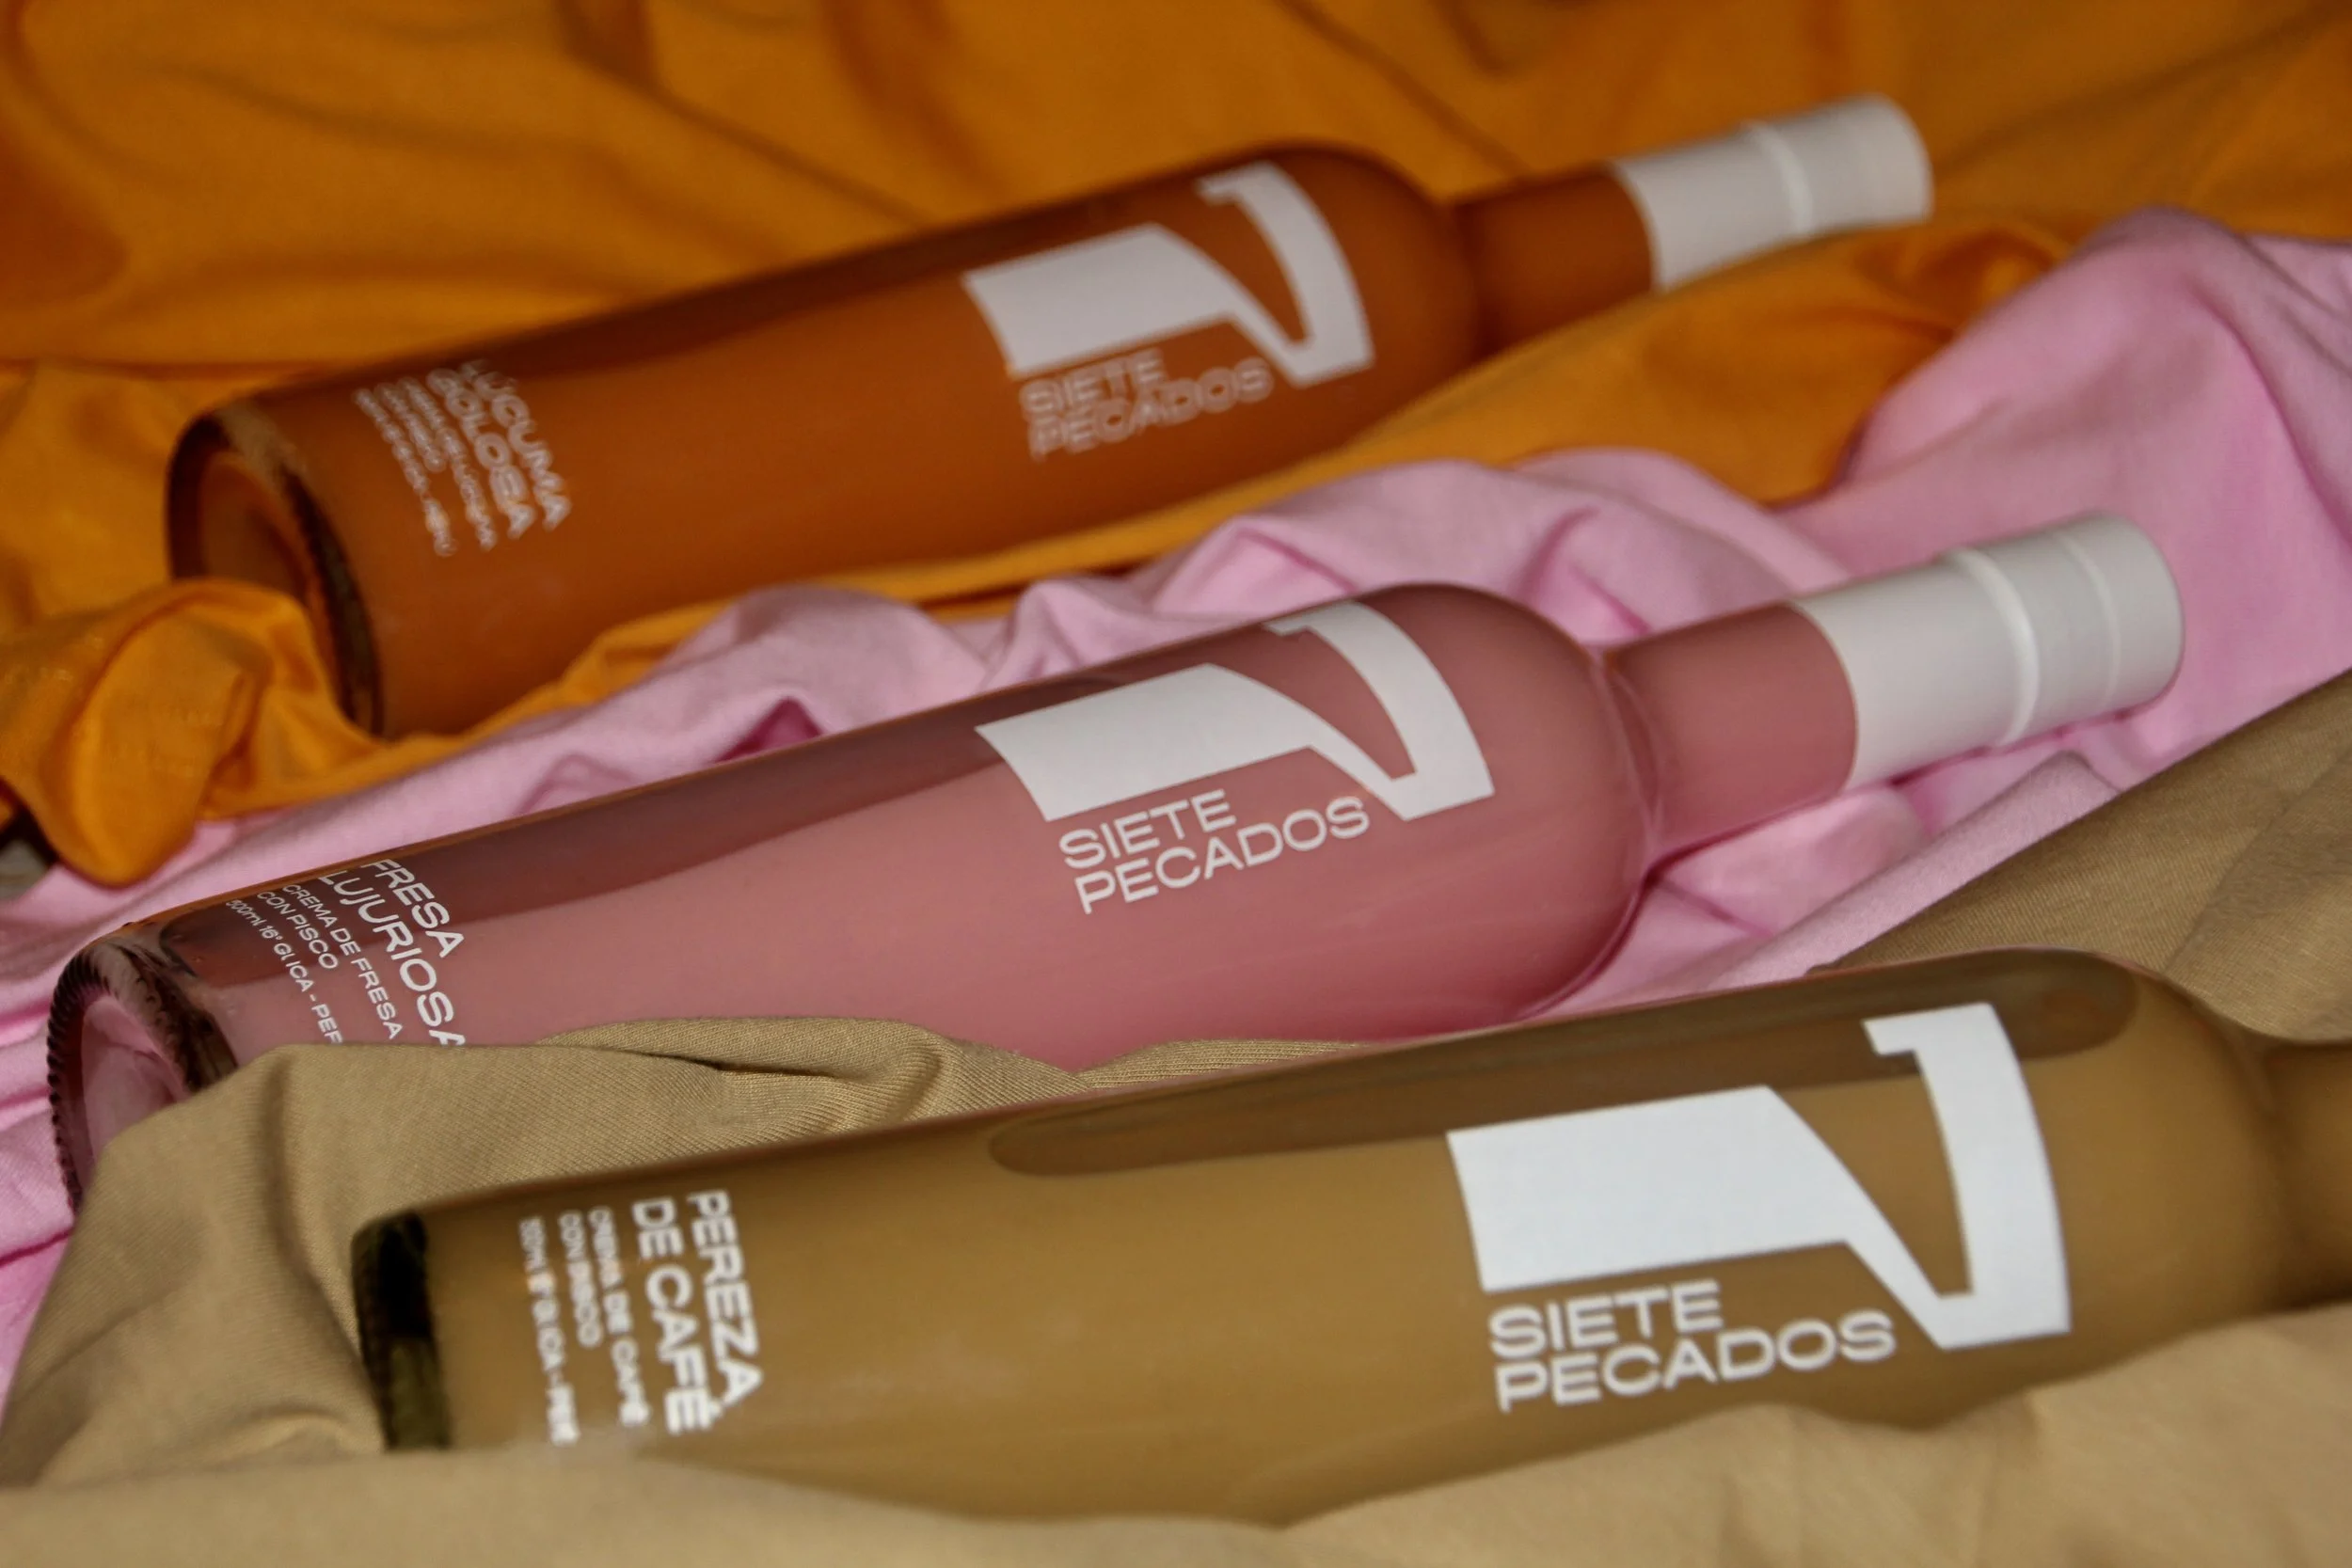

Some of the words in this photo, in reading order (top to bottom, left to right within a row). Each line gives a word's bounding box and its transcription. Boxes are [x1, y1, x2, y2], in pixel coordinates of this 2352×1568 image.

[1020, 347, 1166, 419] SIETE
[1028, 356, 1275, 462] PECADOS
[1058, 789, 1237, 869] SIETE
[1074, 796, 1370, 914] PECADOS
[257, 892, 297, 914] CON
[286, 913, 338, 969] PISCO
[360, 859, 465, 958] FRESA
[282, 884, 338, 927] CREMA
[329, 927, 360, 956] DE
[350, 957, 403, 1039] FRESA
[285, 960, 314, 992] ICA
[631, 1196, 684, 1260] DE
[686, 1189, 763, 1407] PEREZA
[1488, 1279, 1724, 1358] SIETE
[644, 1264, 724, 1435] CAFÉ
[1494, 1310, 1897, 1413] PECADOS
